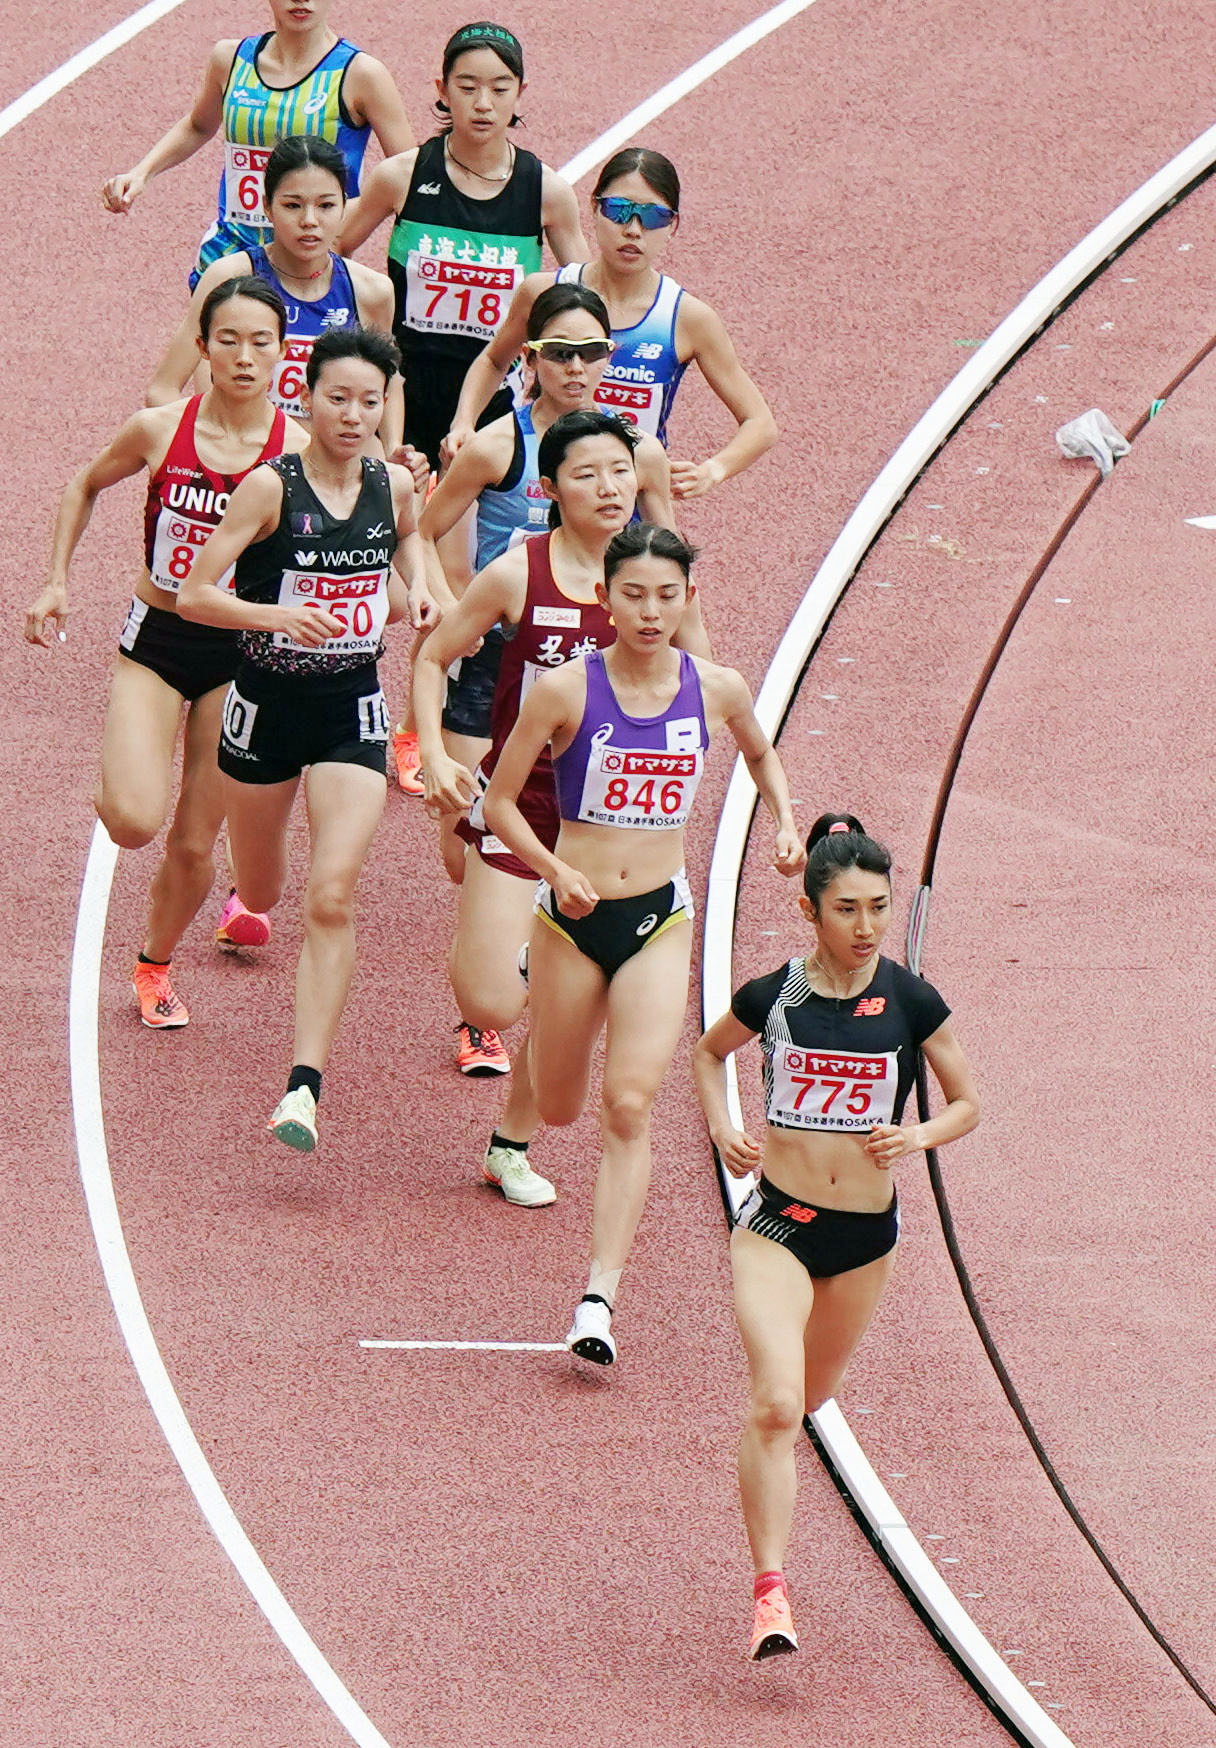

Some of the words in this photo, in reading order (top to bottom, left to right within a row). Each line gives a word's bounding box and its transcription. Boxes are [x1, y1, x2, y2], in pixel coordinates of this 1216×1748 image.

[443, 266, 511, 285] ヤマザキ
[424, 284, 501, 326] 718
[601, 364, 656, 383] sonic
[598, 387, 649, 406] マザキ
[166, 465, 204, 480] LifeWear
[321, 548, 390, 567] WACOAL
[320, 579, 378, 596] ヤマザキ
[303, 601, 373, 638] 50
[628, 756, 694, 773] ヤマザキ
[603, 778, 685, 815] 846
[810, 1056, 883, 1076] ヤマザキ
[790, 1075, 874, 1115] 775
